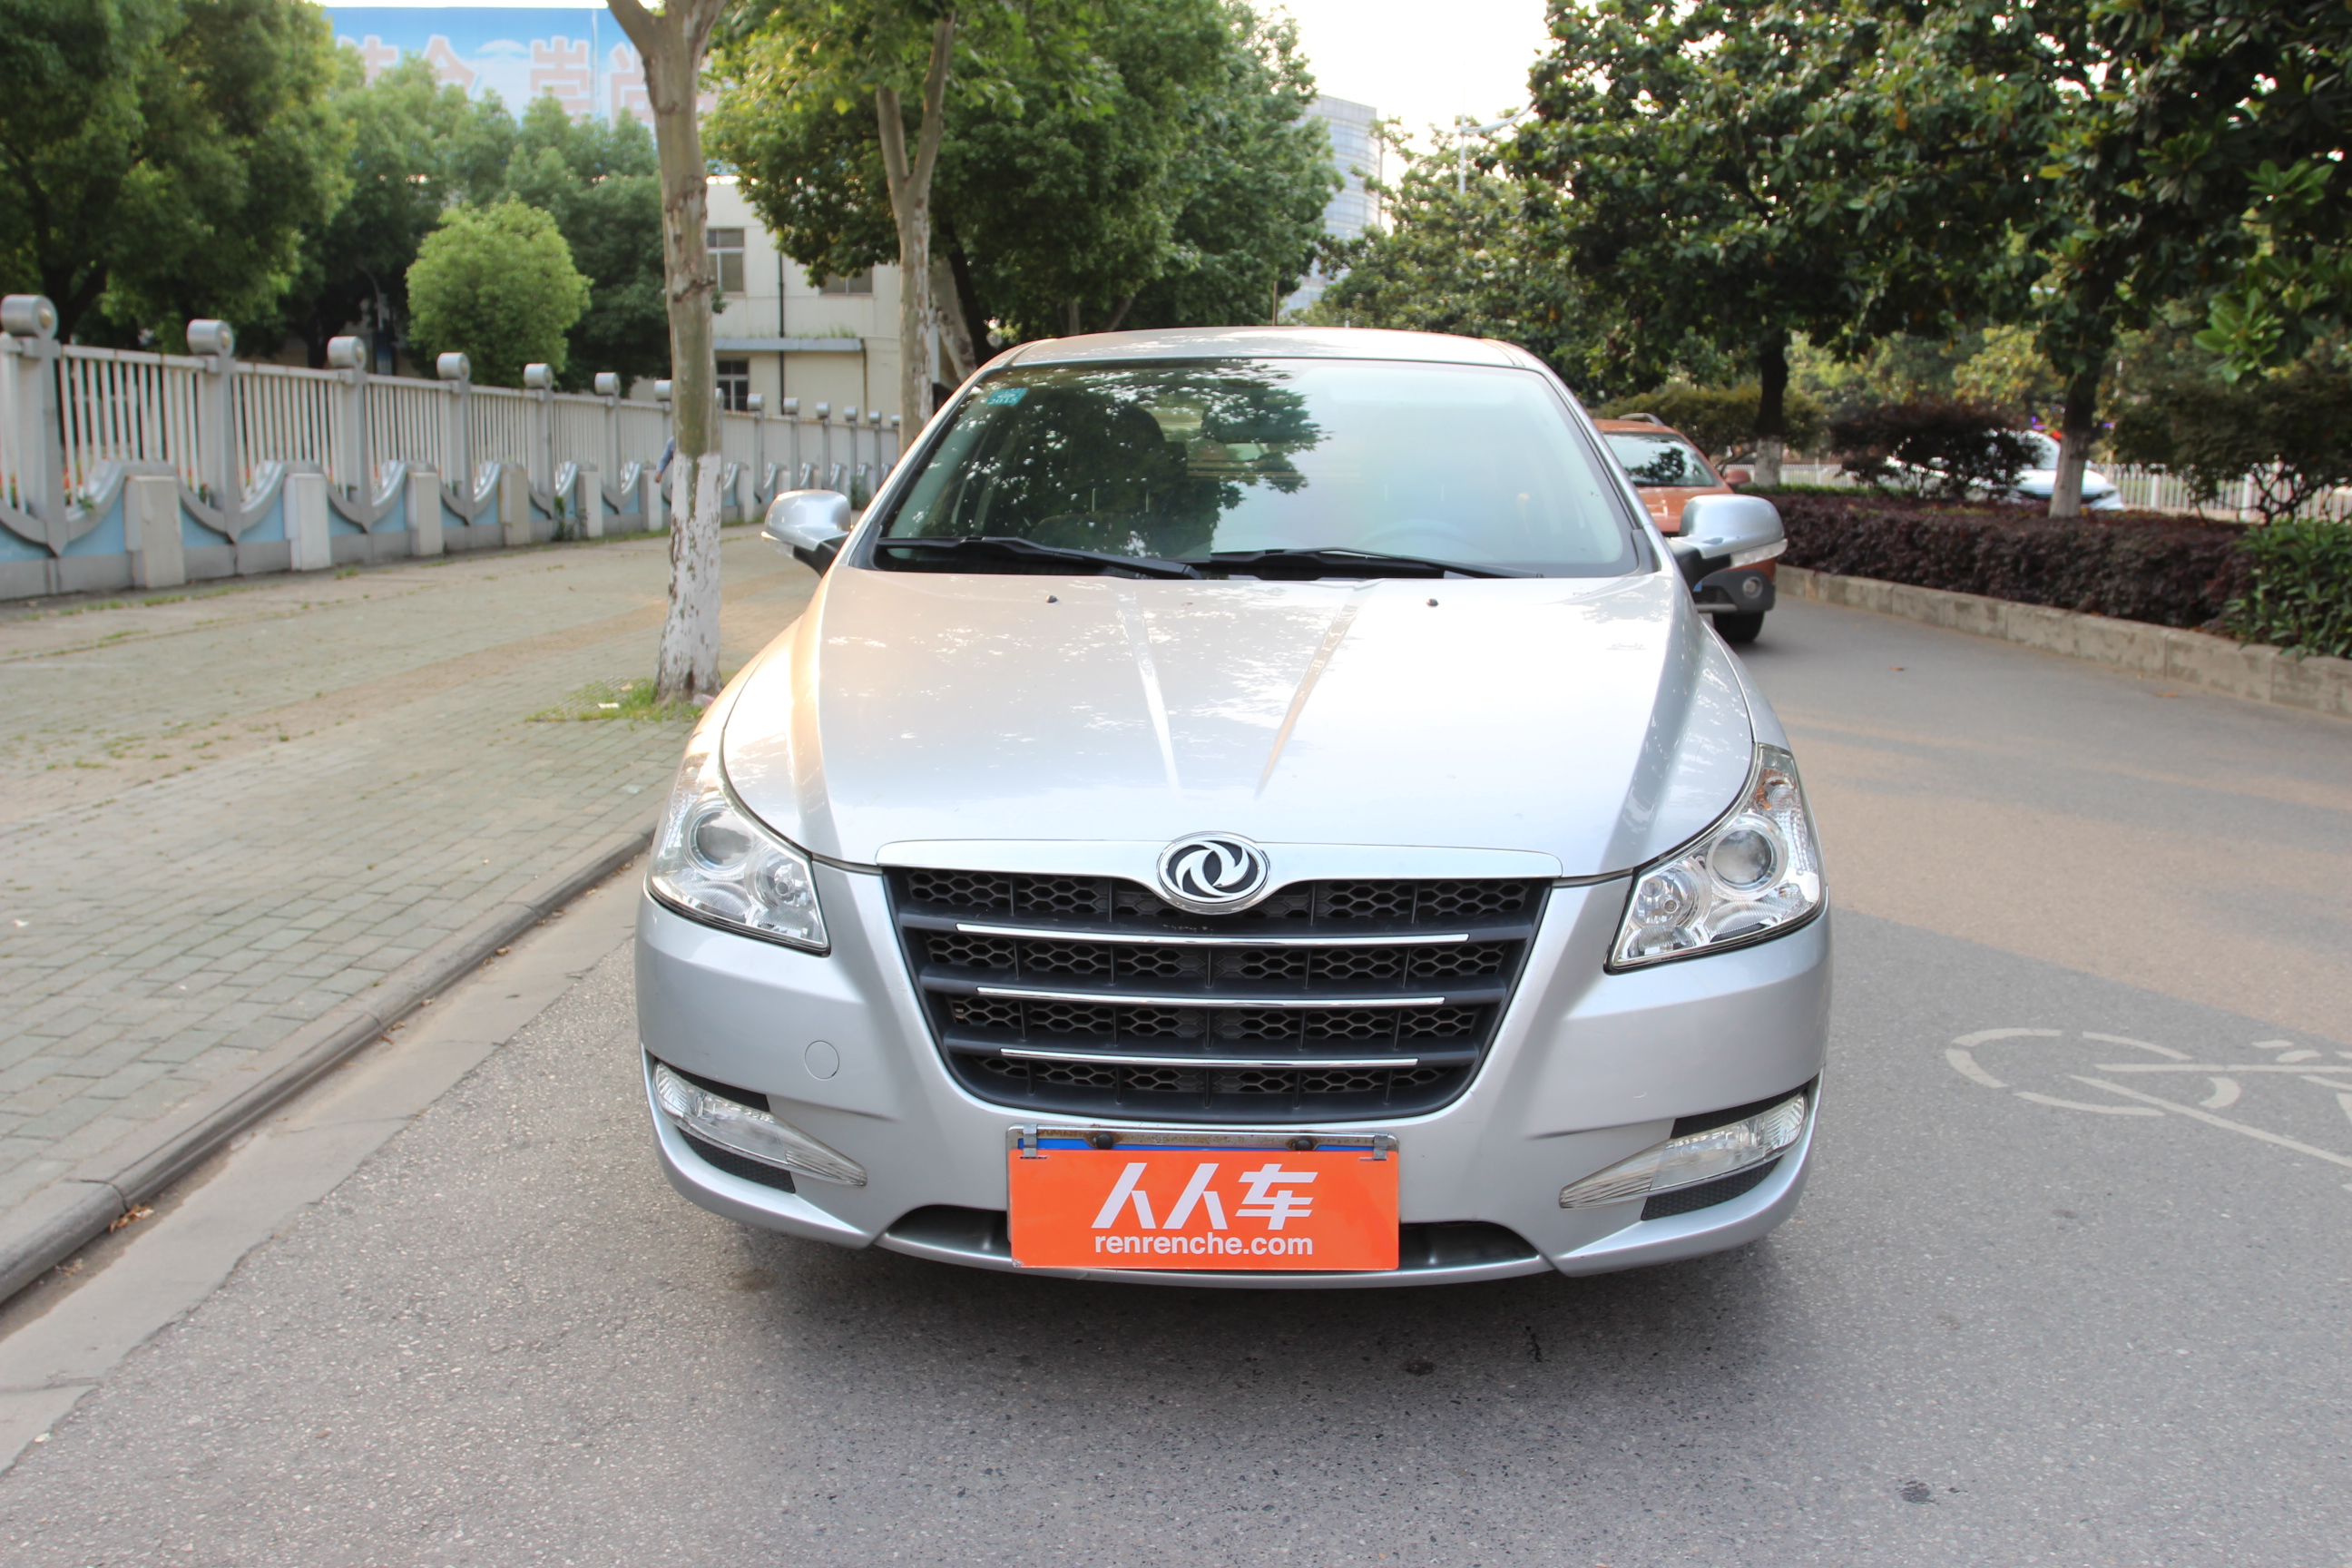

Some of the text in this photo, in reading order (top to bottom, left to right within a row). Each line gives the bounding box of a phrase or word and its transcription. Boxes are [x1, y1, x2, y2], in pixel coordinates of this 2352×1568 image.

[1091, 1162, 1318, 1230] 人人车
[1094, 1232, 1313, 1255] renrenche.com
